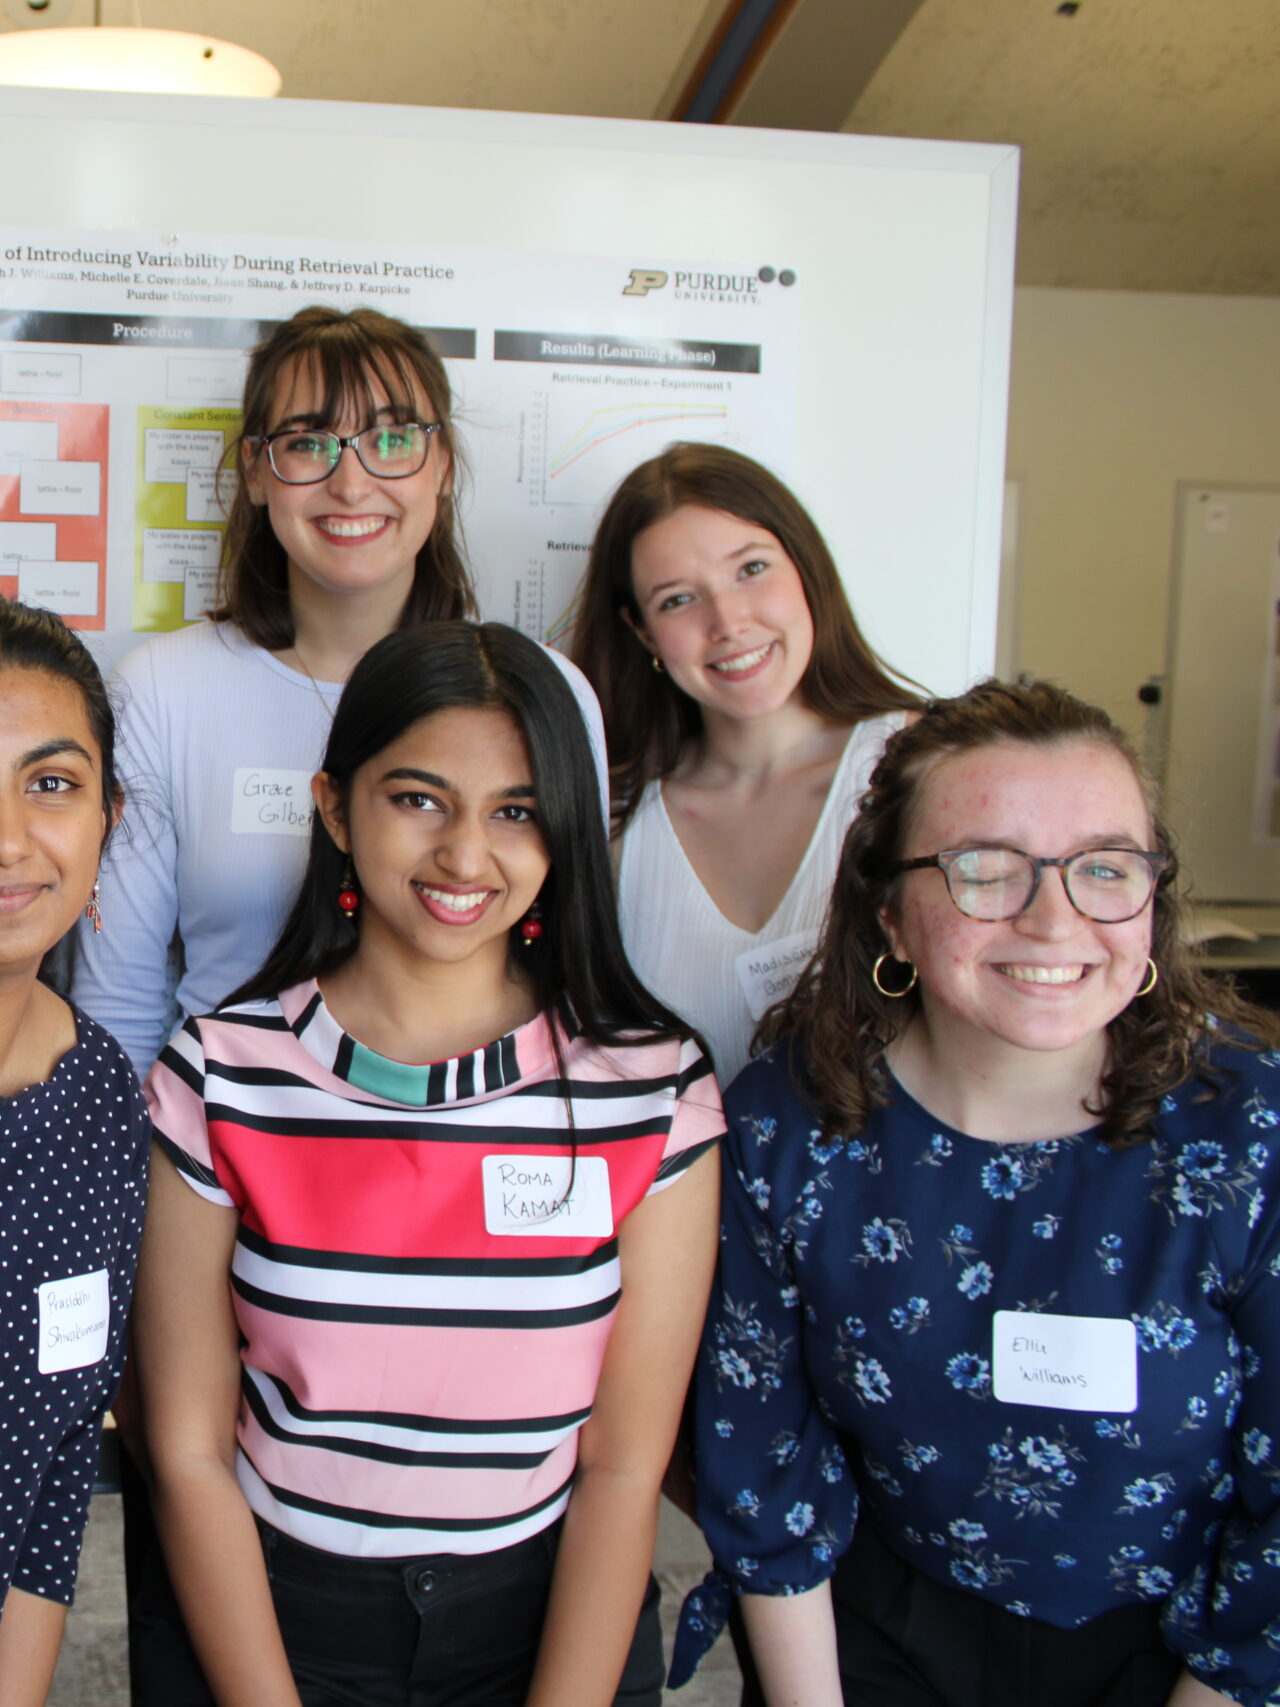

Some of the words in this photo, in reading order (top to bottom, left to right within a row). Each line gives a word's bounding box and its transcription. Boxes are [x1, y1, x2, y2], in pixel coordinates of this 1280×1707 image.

[5, 246, 22, 261] of
[26, 246, 132, 268] Introducing
[137, 251, 228, 270] Variability
[233, 254, 294, 274] During
[299, 257, 378, 276] Retrieval
[382, 262, 455, 280] Practice
[80, 271, 130, 284] Michelle
[134, 273, 144, 284] E.
[147, 274, 211, 288] Coverdale,
[302, 280, 341, 293] Jeffrey
[344, 281, 356, 292] D.
[359, 282, 410, 296] Karpicke
[674, 272, 758, 293] PURDUE
[126, 289, 168, 302] Purdue
[172, 290, 234, 304] University
[112, 322, 193, 339] Procedure
[542, 340, 595, 356] Results
[598, 342, 665, 362] (Learning
[552, 371, 602, 385] Retrieval
[605, 374, 650, 388] Practice
[661, 377, 724, 391] Experiment
[243, 773, 295, 797] Grace
[258, 800, 313, 827] Gilbe
